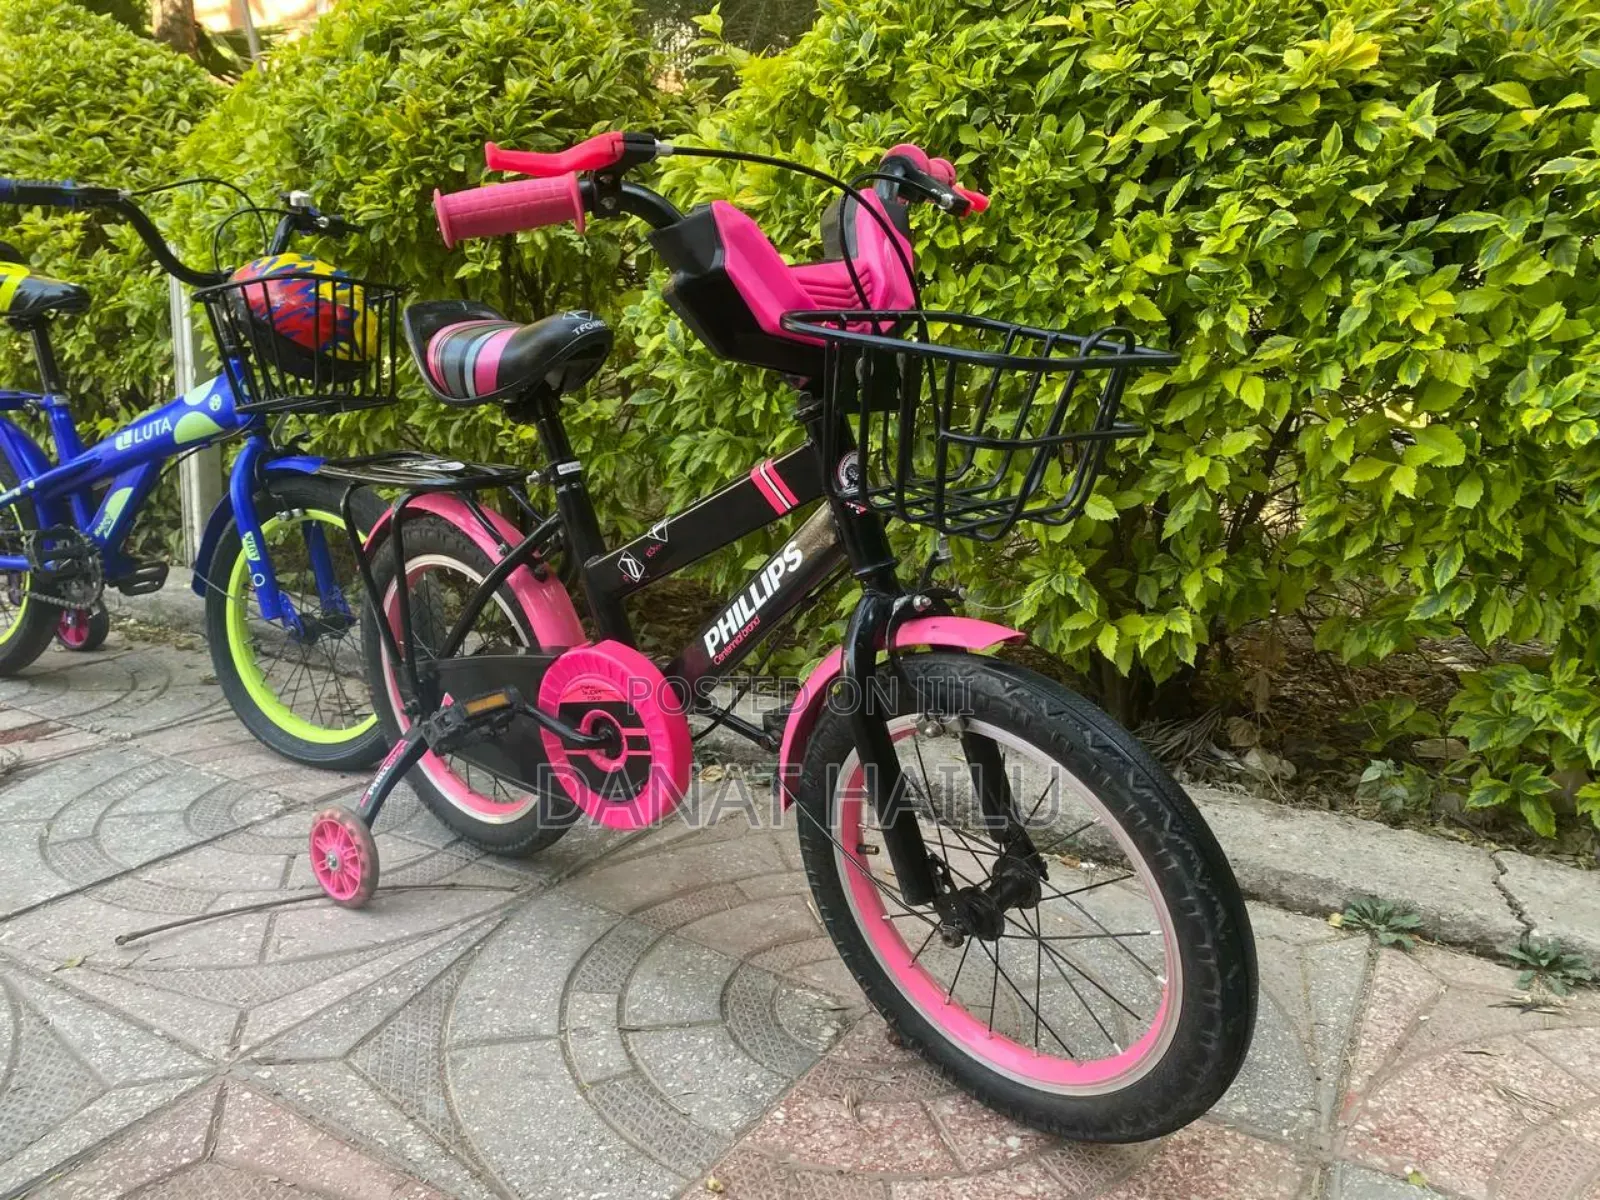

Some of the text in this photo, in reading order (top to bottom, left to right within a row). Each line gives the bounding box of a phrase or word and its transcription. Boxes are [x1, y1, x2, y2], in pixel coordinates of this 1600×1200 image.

[134, 416, 172, 443] LUTA
[703, 540, 803, 658] PHILLIPS
[741, 614, 761, 638] brand
